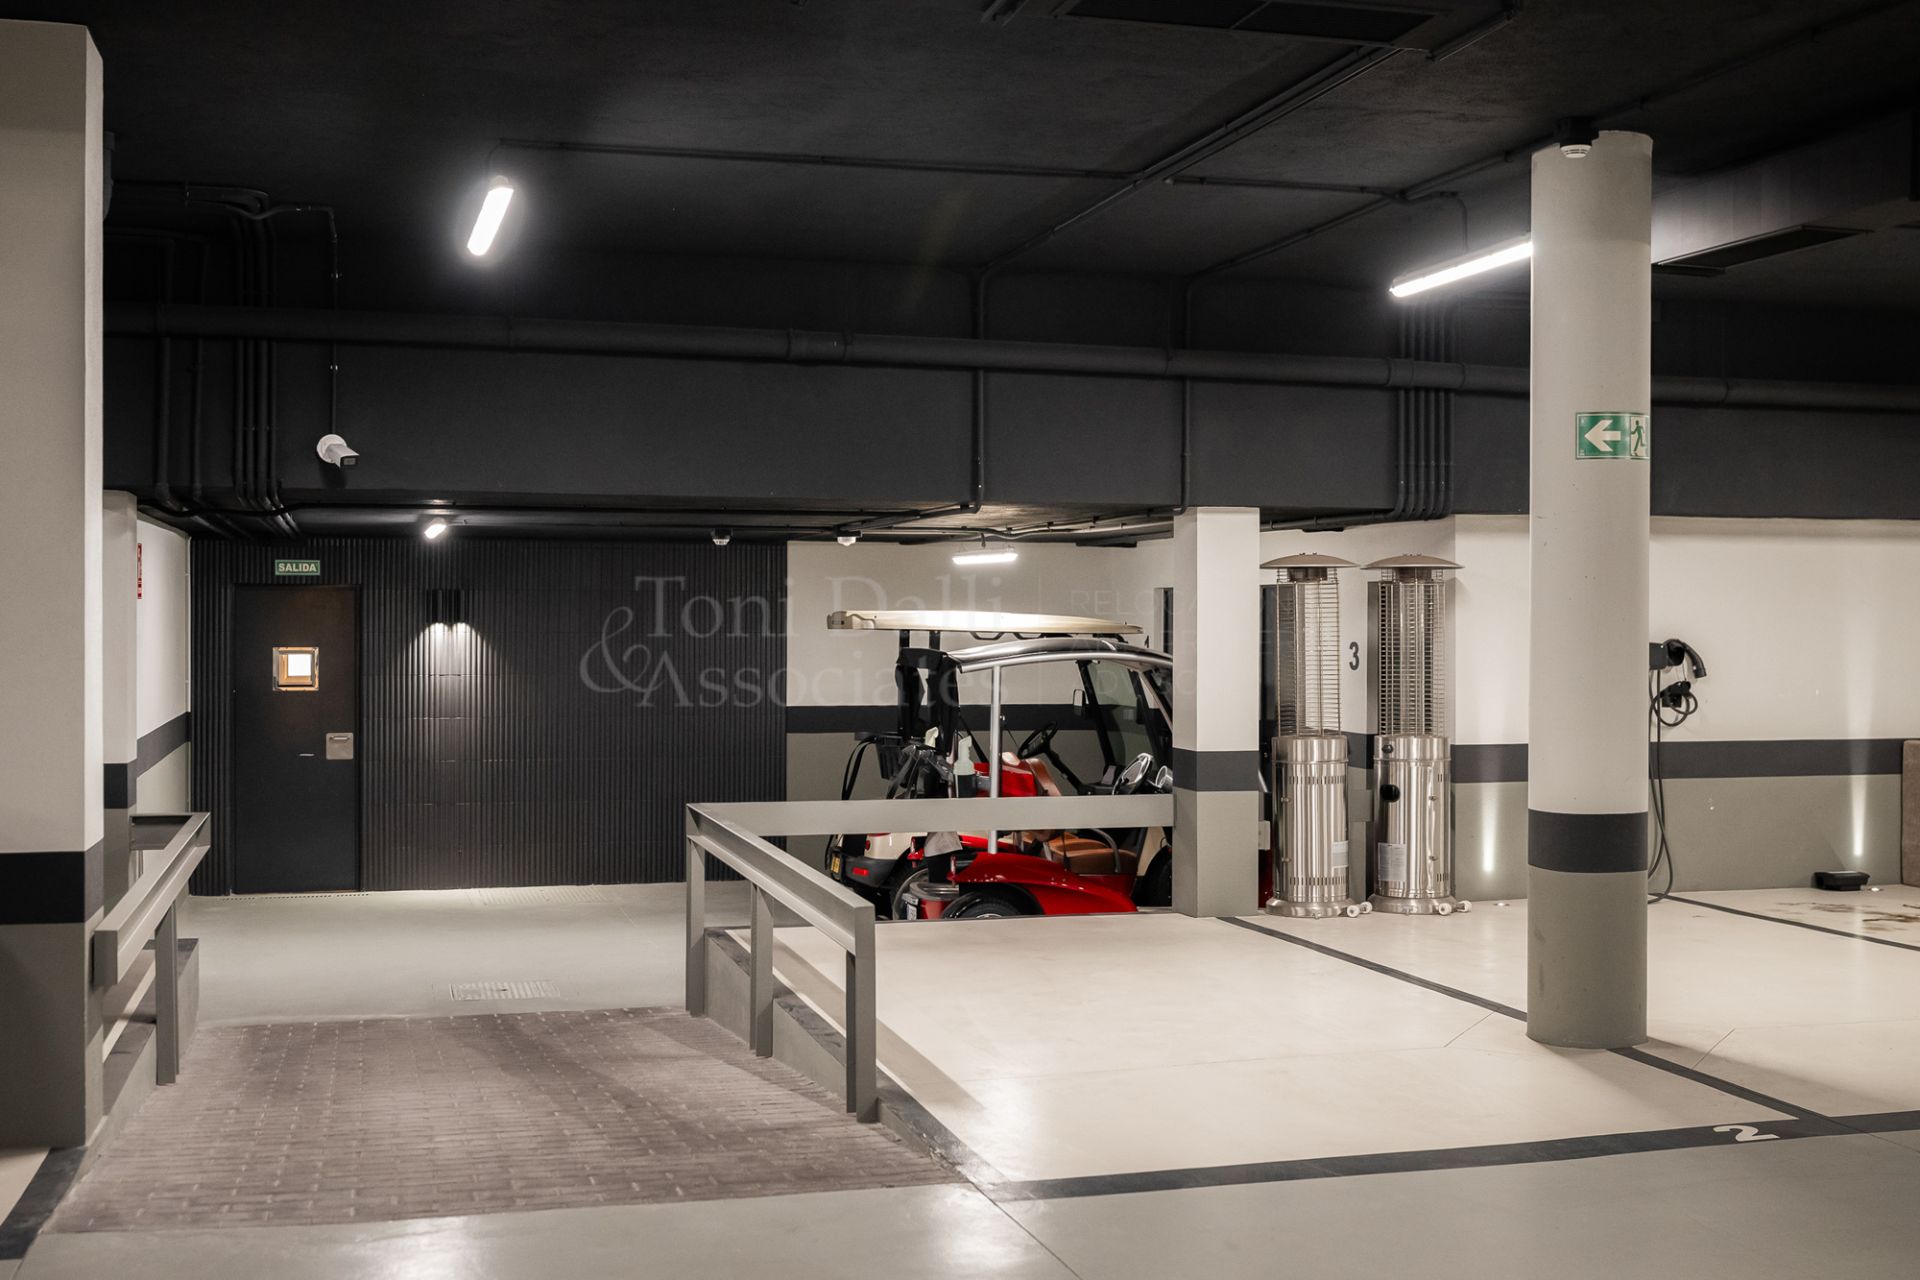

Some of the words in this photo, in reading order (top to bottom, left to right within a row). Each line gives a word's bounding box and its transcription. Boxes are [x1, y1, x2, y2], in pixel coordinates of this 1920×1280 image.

[278, 562, 317, 572] SALIDA
[1349, 641, 1360, 671] 3
[1712, 1124, 1781, 1142] 2
